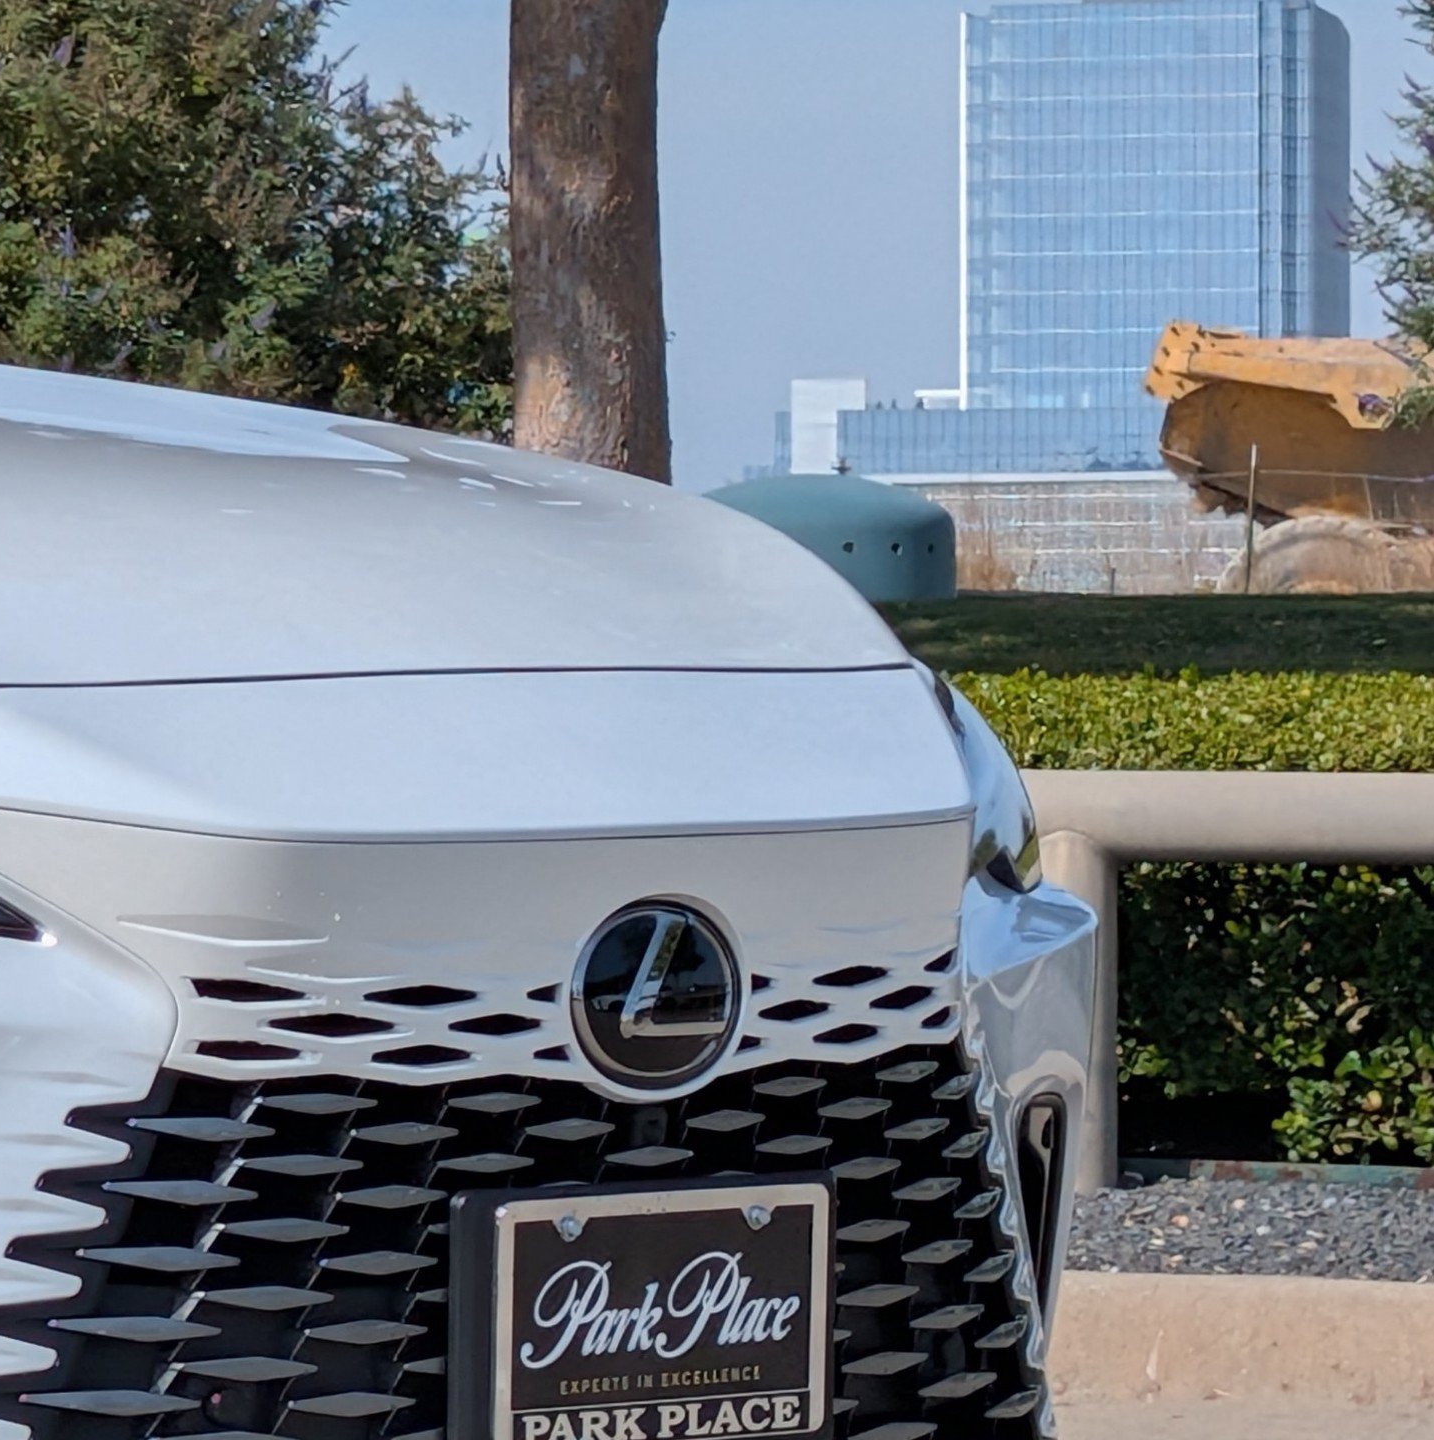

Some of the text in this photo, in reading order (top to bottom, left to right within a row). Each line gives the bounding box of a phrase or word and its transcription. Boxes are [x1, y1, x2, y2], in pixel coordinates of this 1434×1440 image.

[519, 1250, 801, 1369] Park Place
[559, 1364, 762, 1396] EXPERTS IN EXCELLENCE
[655, 1394, 802, 1439] PLACE
